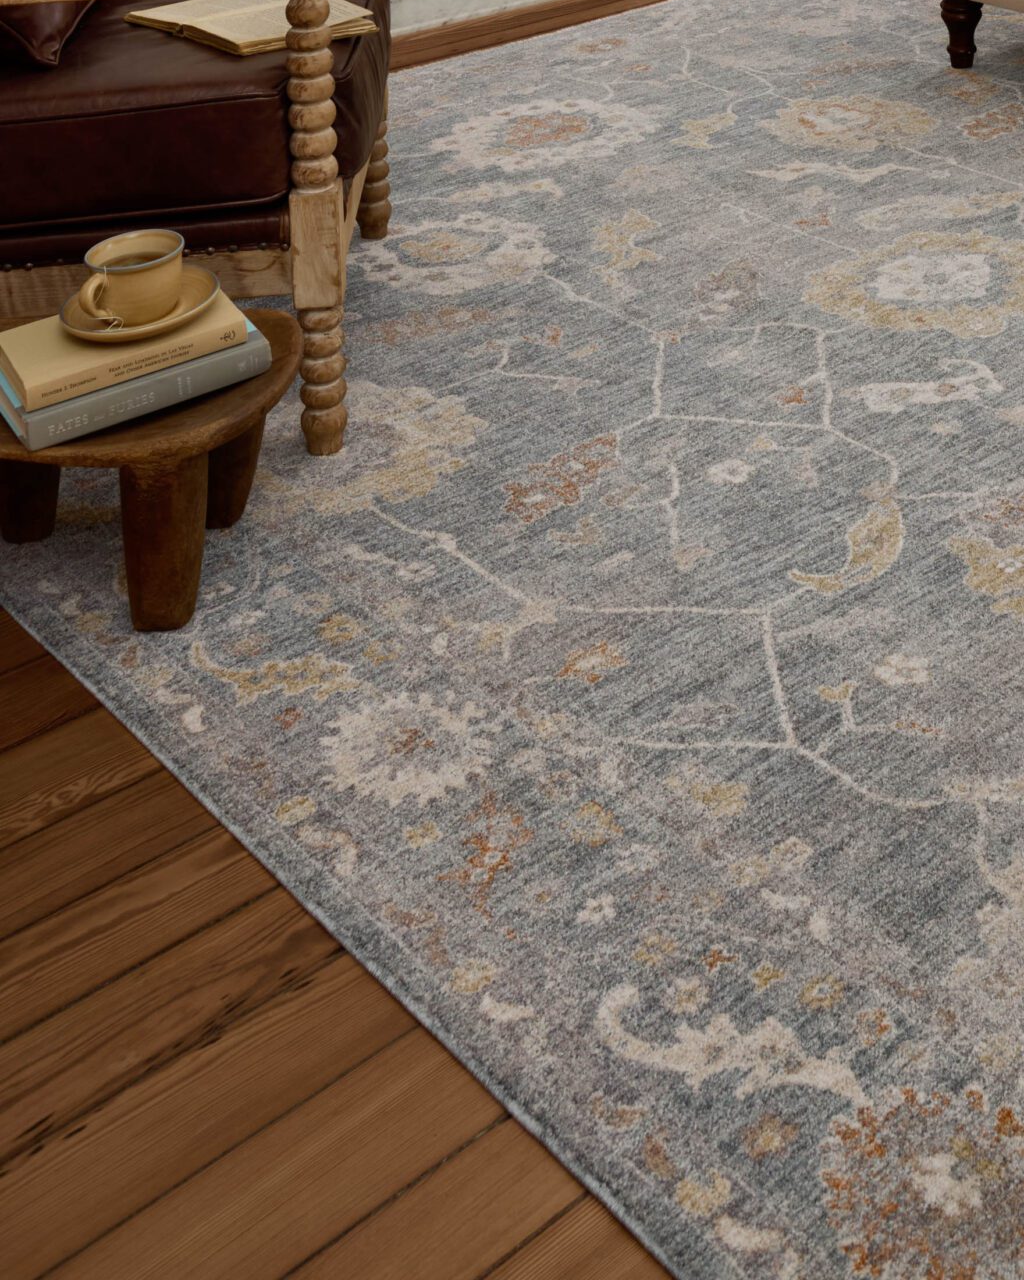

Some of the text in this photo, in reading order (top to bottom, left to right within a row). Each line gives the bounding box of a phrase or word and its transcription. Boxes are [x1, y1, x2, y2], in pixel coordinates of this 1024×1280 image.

[178, 343, 194, 352] VEGAS
[126, 365, 143, 373] OTHER
[144, 358, 169, 368] AMERICAN
[42, 388, 62, 398] HUNTER
[70, 377, 96, 389] THOMPSON
[48, 414, 89, 436] FATES
[108, 392, 155, 416] FURIES
